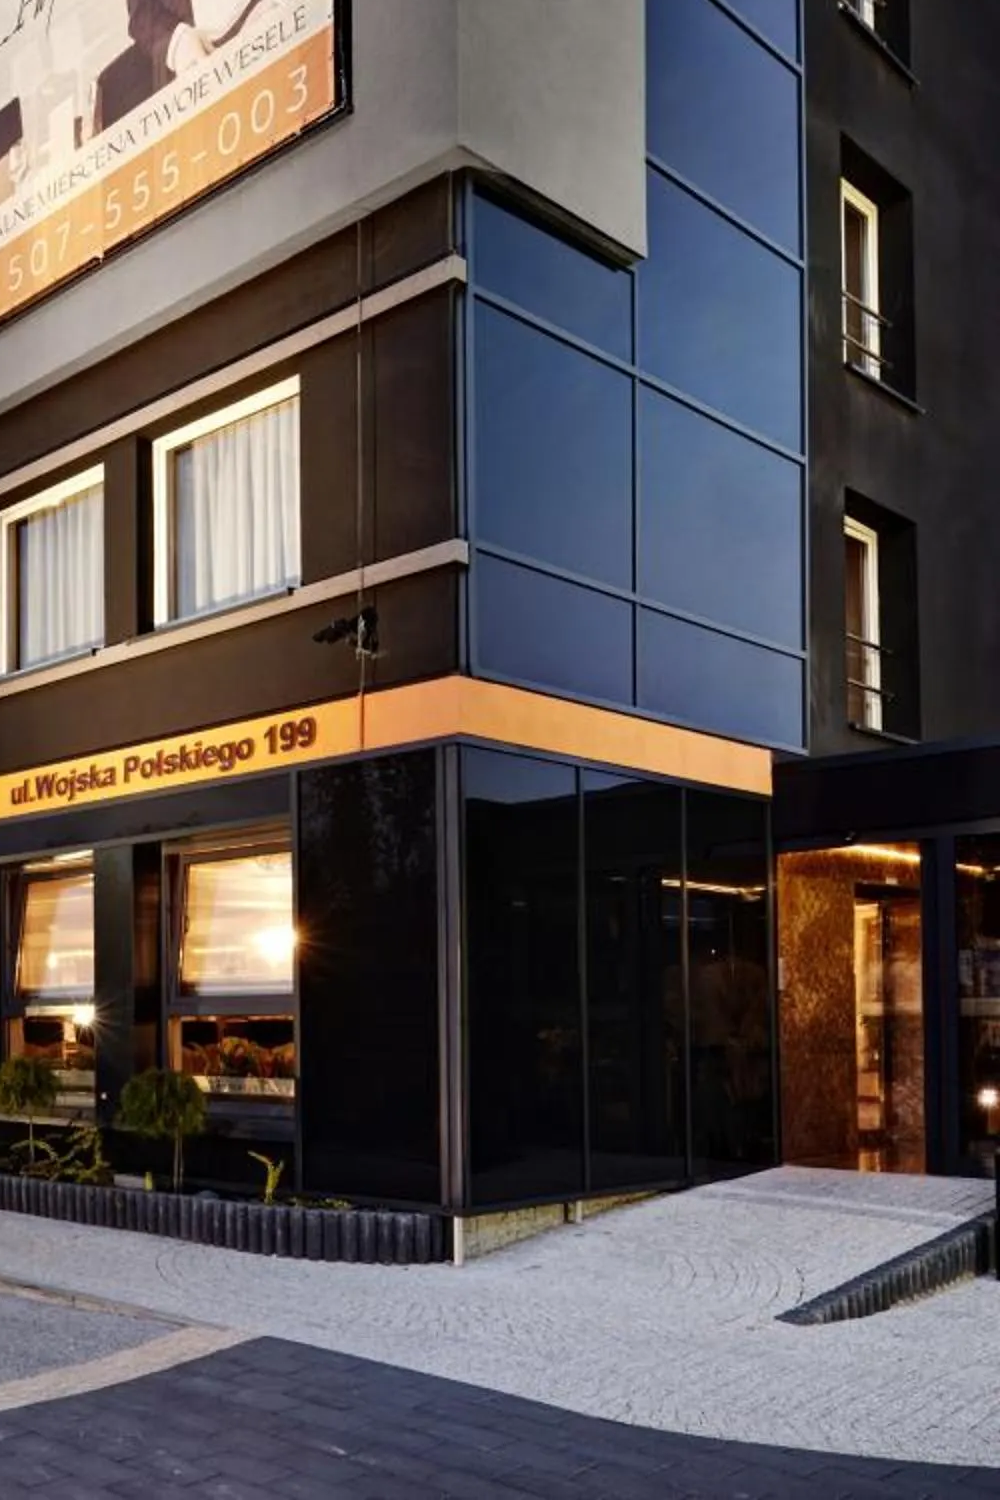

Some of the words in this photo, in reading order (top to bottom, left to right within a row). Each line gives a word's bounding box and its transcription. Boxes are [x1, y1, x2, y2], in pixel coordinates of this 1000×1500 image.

[140, 72, 212, 138] TWOJE
[213, 4, 308, 86] WESELE
[7, 64, 308, 293] 507-555-003
[123, 736, 255, 784] Polskiego
[263, 716, 317, 755] 199
